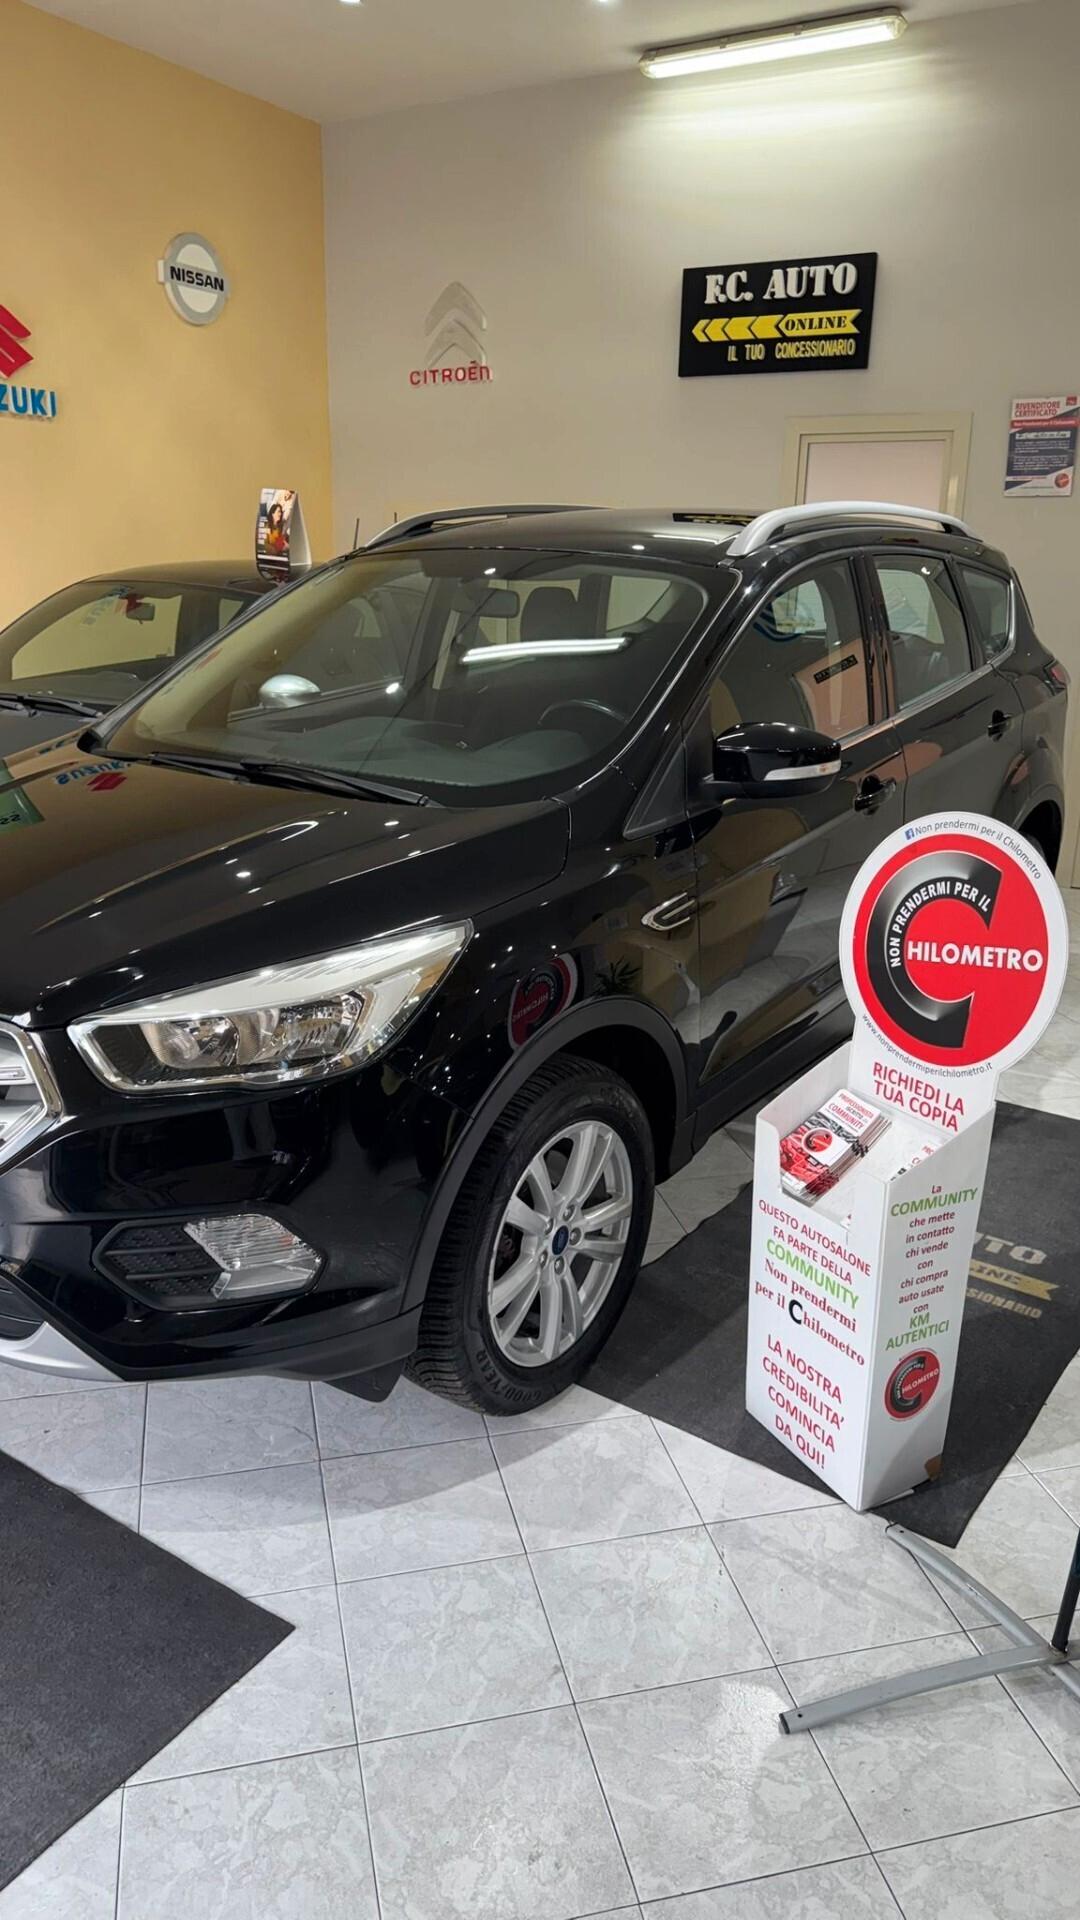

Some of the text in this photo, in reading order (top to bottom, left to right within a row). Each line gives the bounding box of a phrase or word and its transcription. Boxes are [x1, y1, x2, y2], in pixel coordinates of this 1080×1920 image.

[170, 266, 224, 291] NISSAN
[704, 262, 858, 304] F.C. AUTO
[785, 316, 847, 331] ONLINE
[727, 338, 856, 362] IL TUO CONCESSIONARIO
[914, 820, 1042, 880] Non prendermi per il Chilometro
[889, 881, 991, 968] NON PRENDERMI PER IL
[862, 1014, 993, 1078] www.nonprendermiperilchilometro.it
[873, 1062, 964, 1115] RICHIEDI LA
[874, 1080, 959, 1131] TUA COPIA
[890, 1188, 978, 1217] COMMUNITY
[931, 1185, 942, 1194] La
[905, 1225, 955, 1244] in contatto
[909, 1211, 955, 1228] che mette
[759, 1199, 871, 1277] QUESTO AUTOSALONE
[905, 1240, 949, 1259] chi vende
[975, 1232, 1047, 1265] TO
[773, 1226, 852, 1285] FA PARTE DELLA
[917, 1259, 934, 1270] con
[766, 1239, 859, 1310] COMMUNITY
[900, 1269, 949, 1289] chi compra
[764, 1258, 857, 1333] Non prendermi
[898, 1283, 945, 1304] auto usate
[913, 1303, 929, 1314] con
[755, 1280, 865, 1366] per il Chilometro
[885, 1320, 950, 1350] AUTENTICI
[909, 1312, 930, 1329] KM
[768, 1333, 842, 1404] LA NOSTRA
[768, 1385, 835, 1452] COMINCIA
[775, 1414, 825, 1469] DA QUI!
